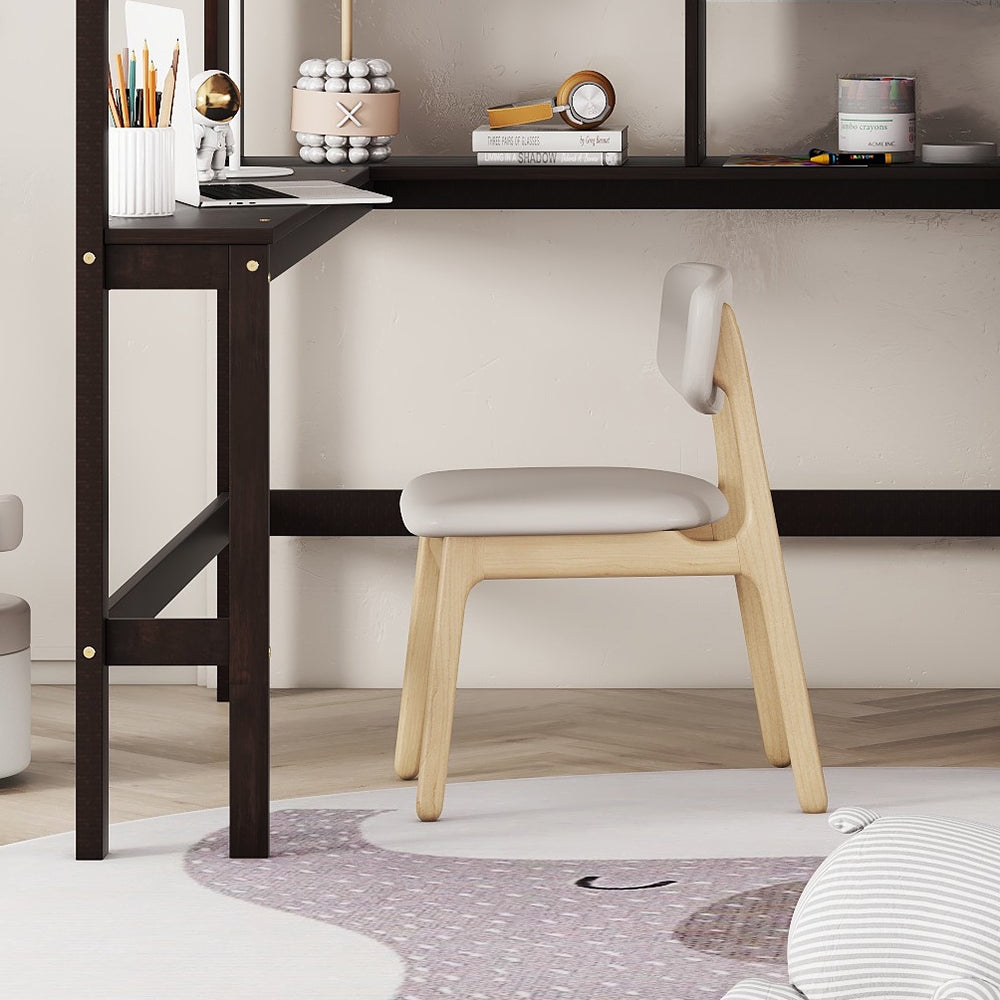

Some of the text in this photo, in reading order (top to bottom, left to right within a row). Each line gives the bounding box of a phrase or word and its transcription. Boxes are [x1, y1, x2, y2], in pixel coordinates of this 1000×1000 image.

[487, 135, 501, 146] THREE
[522, 135, 540, 146] GLASSES
[517, 152, 557, 164] SHADOW
